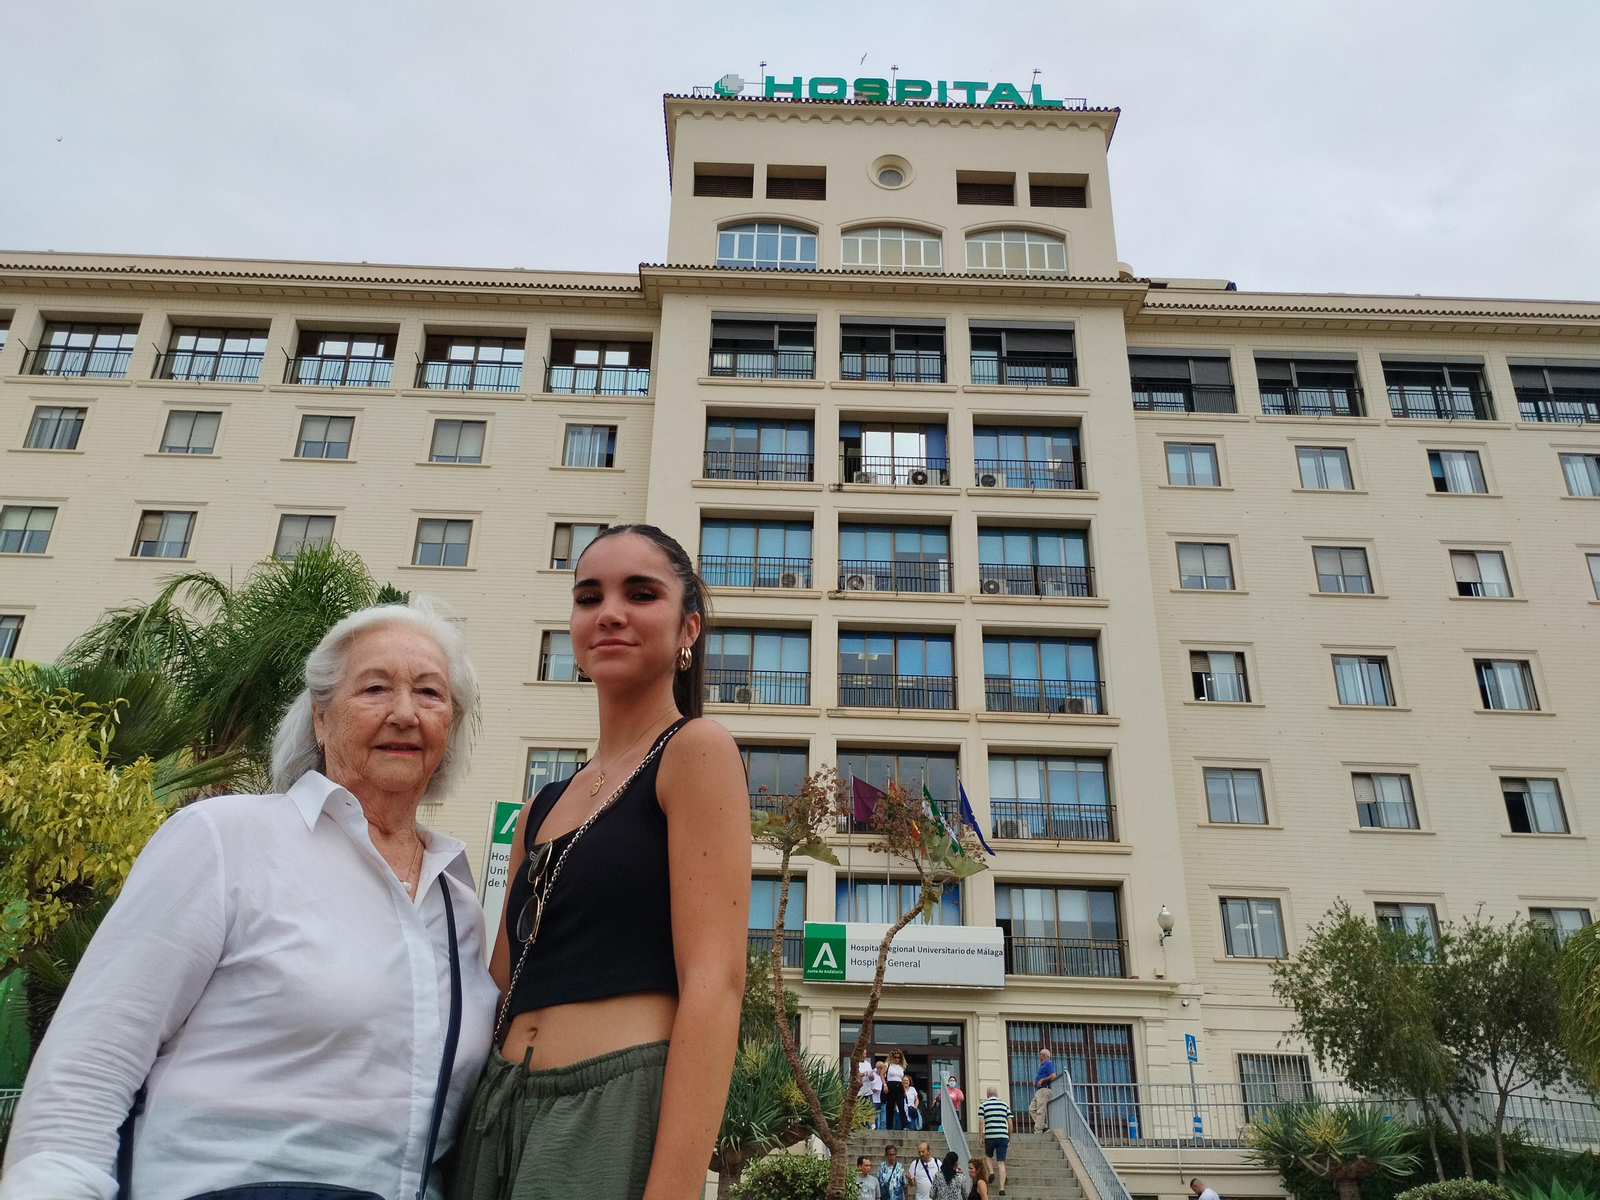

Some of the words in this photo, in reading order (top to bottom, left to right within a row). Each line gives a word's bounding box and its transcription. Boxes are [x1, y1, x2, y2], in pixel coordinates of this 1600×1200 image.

[765, 76, 1063, 107] HOSPITAL
[488, 878, 500, 887] de
[887, 945, 915, 954] egional
[917, 946, 966, 955] Universitario
[966, 947, 976, 955] de
[976, 947, 1004, 957] Málaga
[850, 958, 879, 967] Hospit
[888, 958, 921, 968] General
